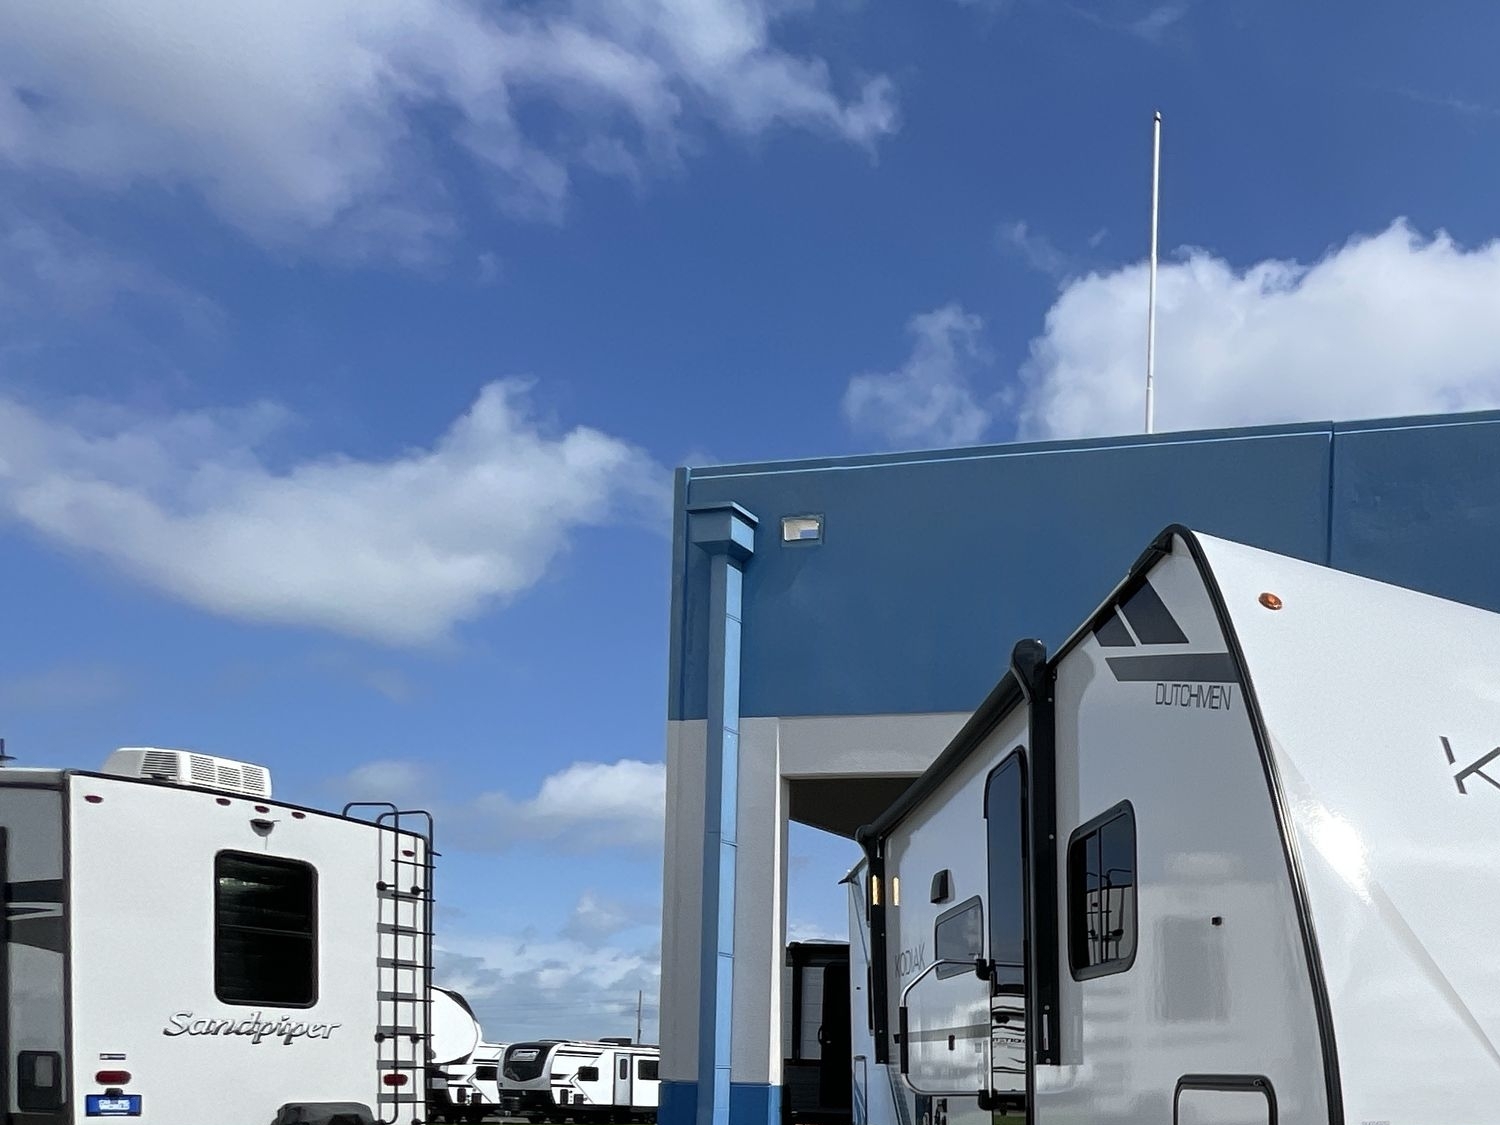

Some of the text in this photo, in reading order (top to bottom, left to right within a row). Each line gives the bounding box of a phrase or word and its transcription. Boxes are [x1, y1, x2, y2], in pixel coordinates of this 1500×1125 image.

[1155, 683, 1232, 711] DUTCHMEN
[894, 942, 926, 979] KODIAK
[162, 1010, 342, 1046] Sandpiper
